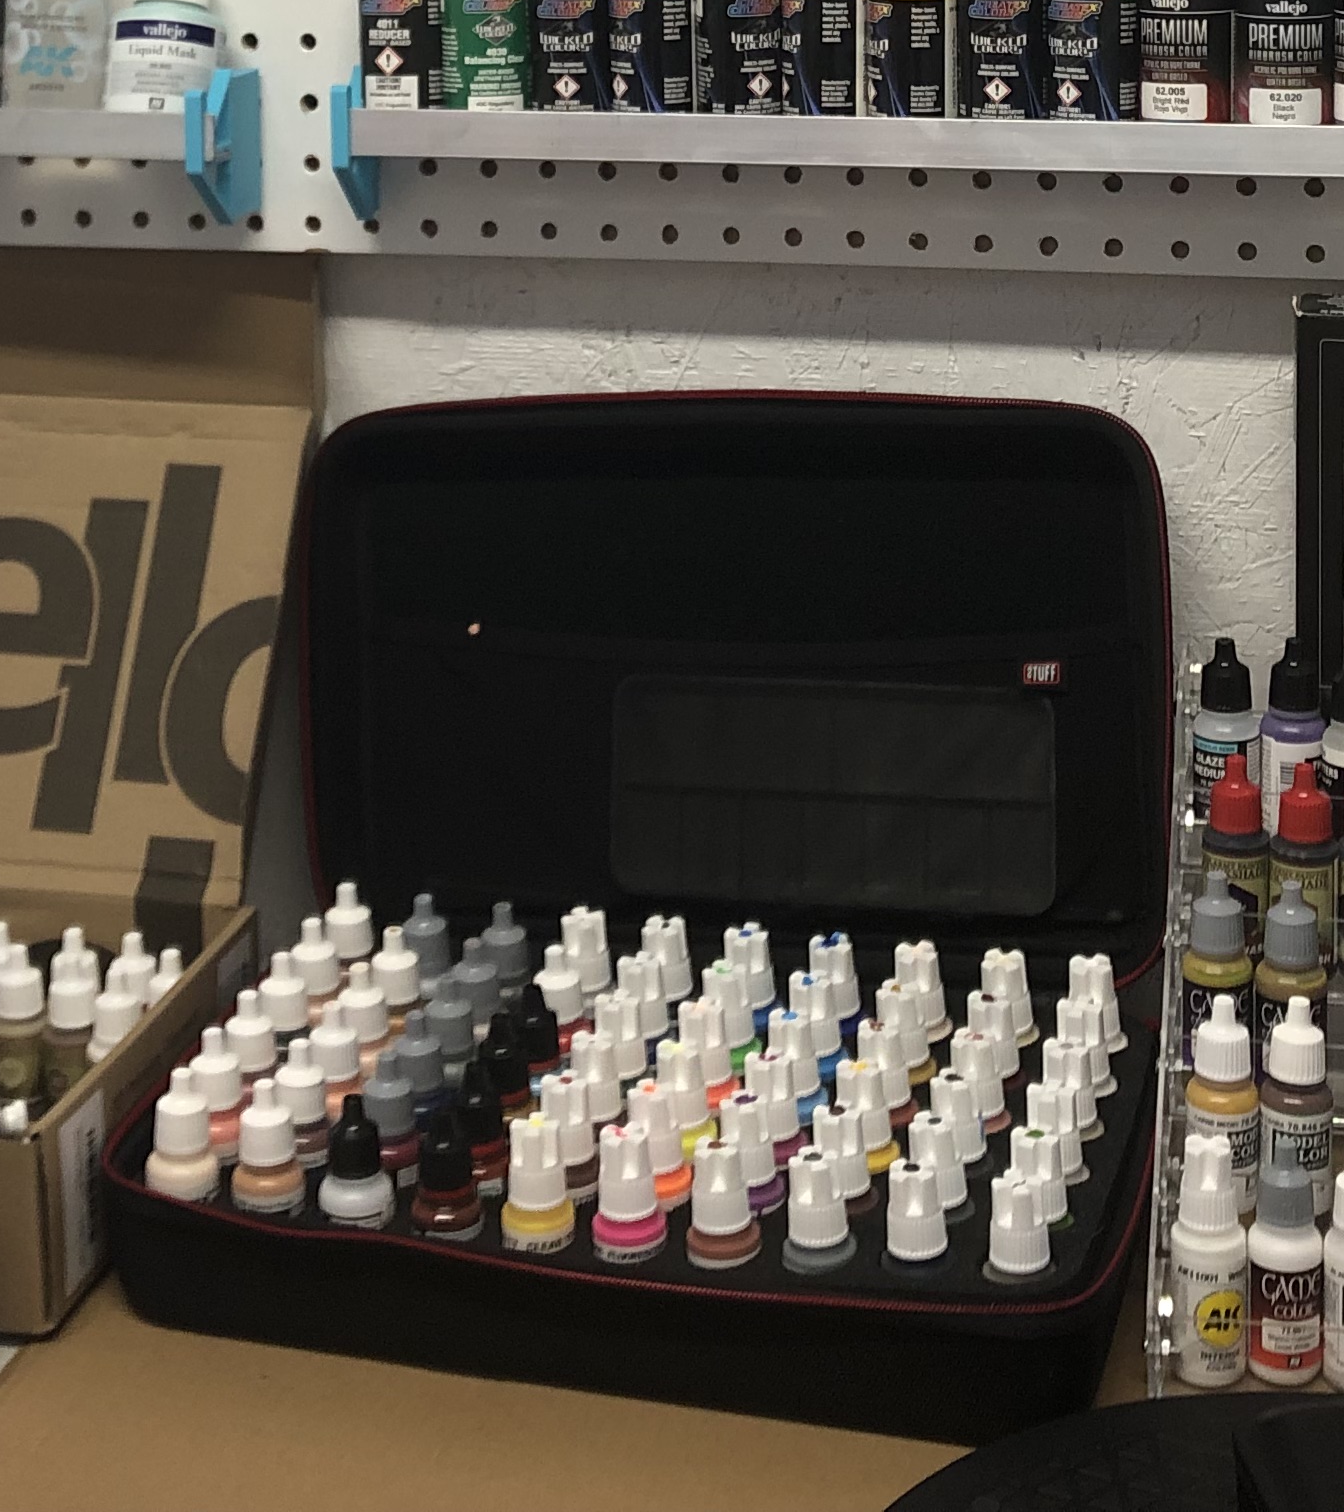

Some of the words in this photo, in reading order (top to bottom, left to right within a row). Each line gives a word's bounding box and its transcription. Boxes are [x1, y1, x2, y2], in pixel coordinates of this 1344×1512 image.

[1265, 0, 1308, 15] vallejo
[143, 23, 187, 39] vallejo
[369, 30, 410, 40] REDUCER
[1141, 19, 1208, 43] PREMIUM
[1249, 23, 1322, 49] PREMIUM
[129, 44, 162, 57] Liquid
[167, 45, 197, 59] Mask
[1249, 50, 1291, 61] AIRBRUSH
[1155, 86, 1185, 96] 62.005
[1270, 93, 1302, 102] 62.020
[1027, 664, 1056, 681] STUFF
[1262, 1273, 1319, 1305] GAME
